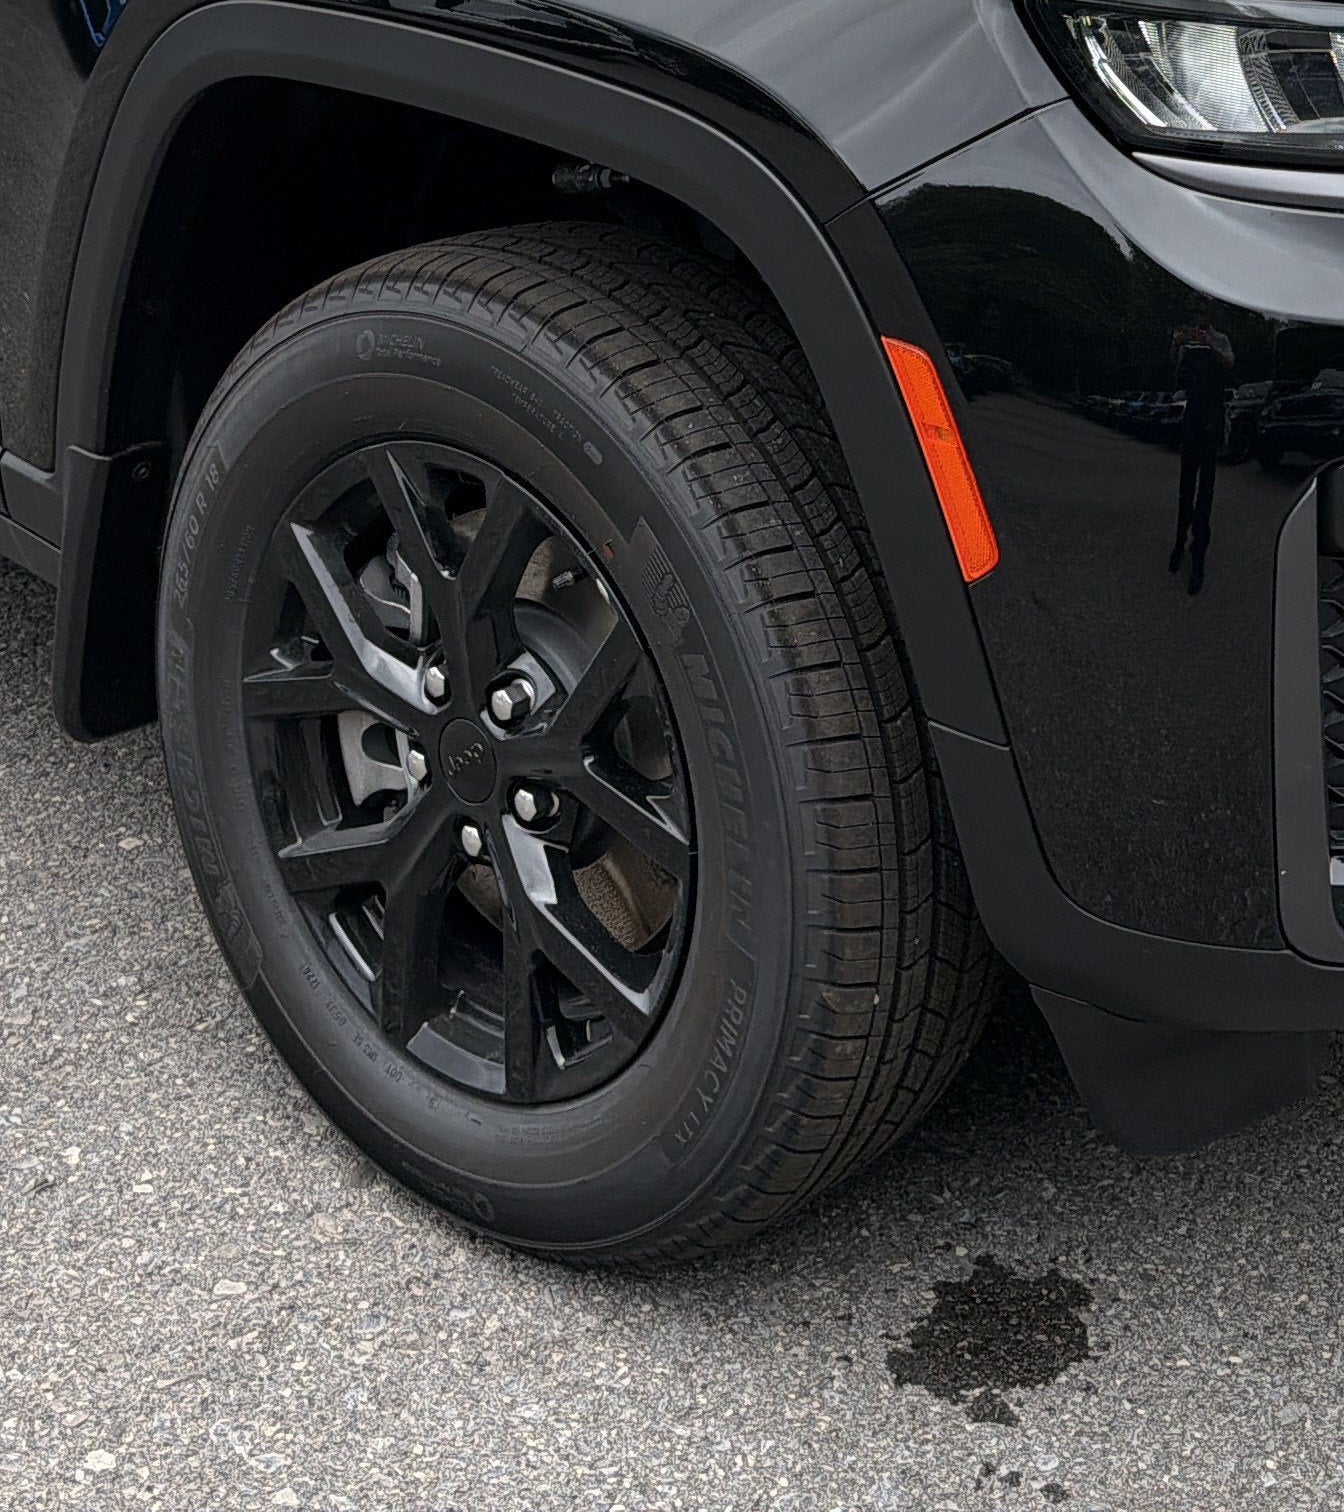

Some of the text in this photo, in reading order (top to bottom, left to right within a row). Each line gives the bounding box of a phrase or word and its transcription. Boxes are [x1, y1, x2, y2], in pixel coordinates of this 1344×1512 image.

[195, 490, 208, 516] R
[204, 462, 219, 492] 18
[678, 652, 753, 931] MICHELIN
[696, 978, 748, 1113] PRIMACY
